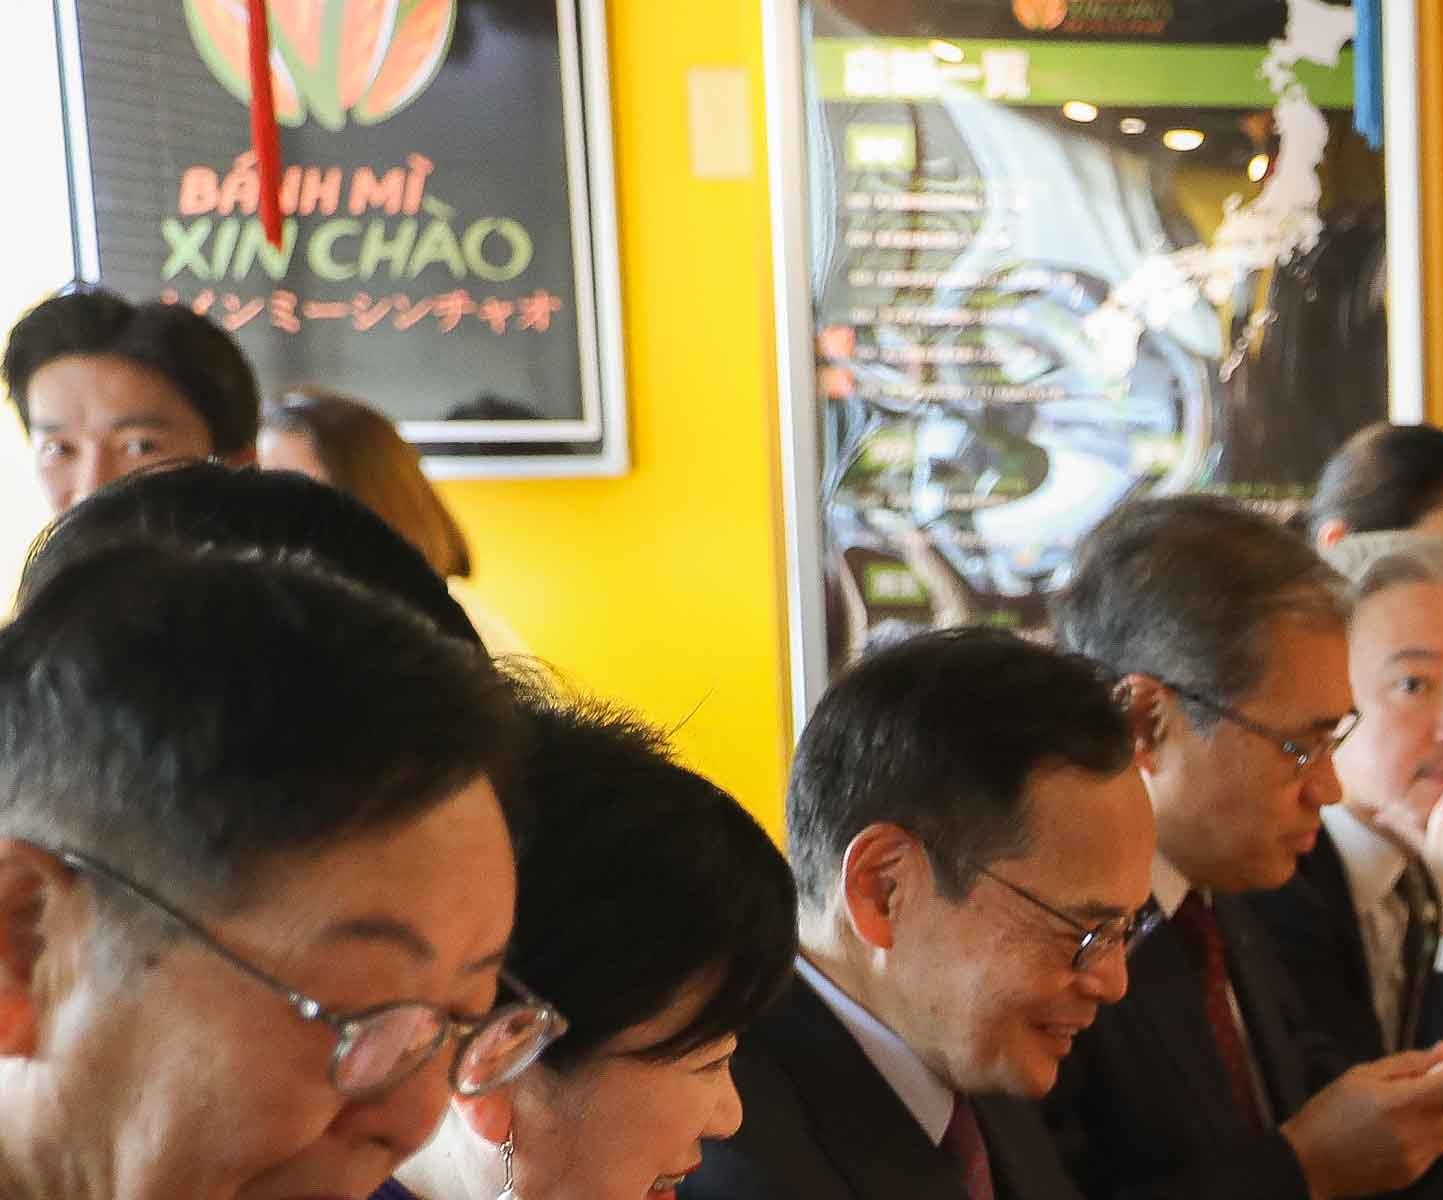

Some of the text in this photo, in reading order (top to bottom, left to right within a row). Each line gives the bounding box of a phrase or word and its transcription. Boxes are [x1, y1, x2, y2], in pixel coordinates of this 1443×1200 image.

[160, 195, 535, 283] XIN CHÀO
[160, 288, 561, 336] ンミーシンチャオ
